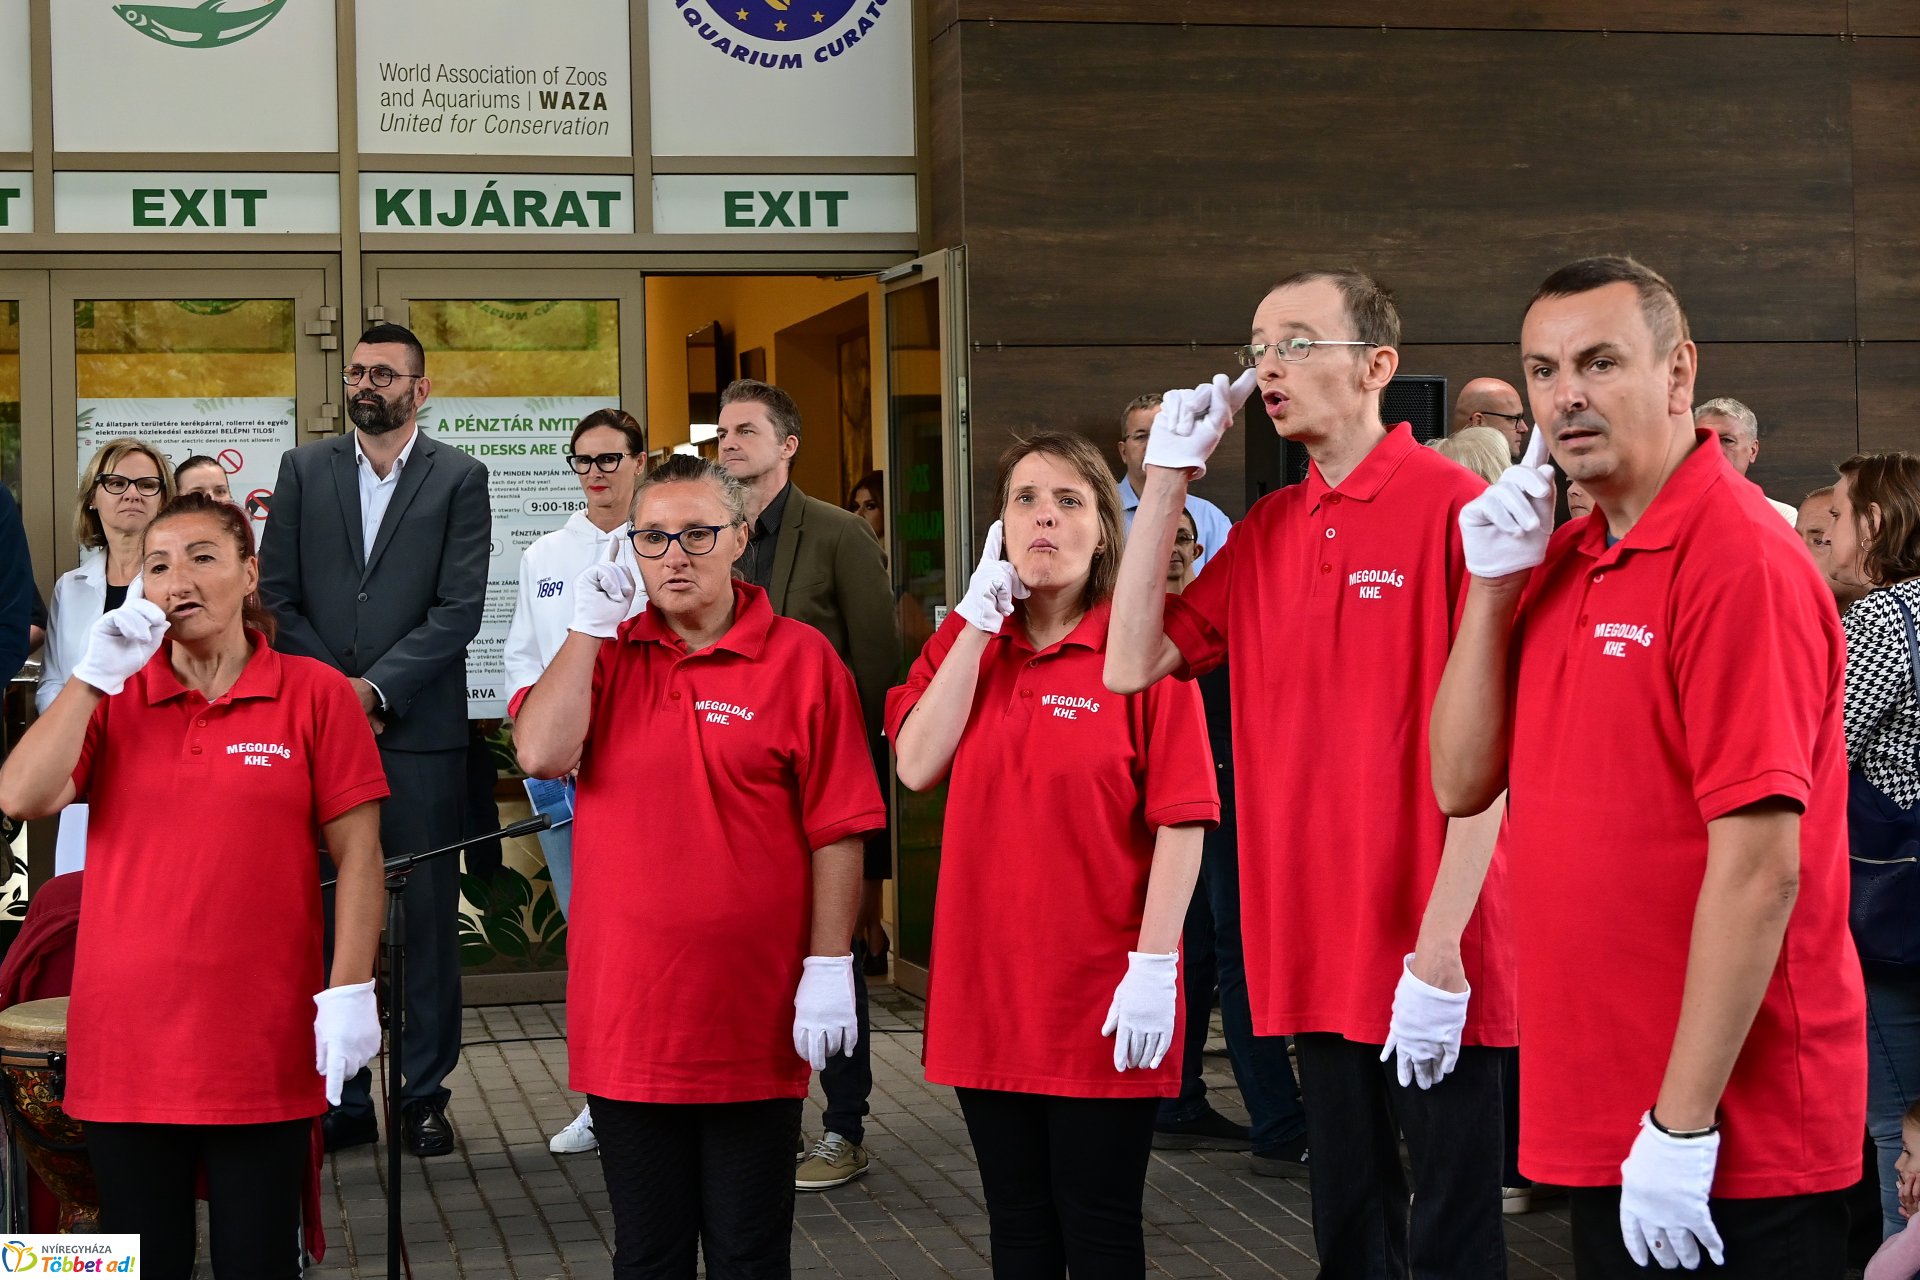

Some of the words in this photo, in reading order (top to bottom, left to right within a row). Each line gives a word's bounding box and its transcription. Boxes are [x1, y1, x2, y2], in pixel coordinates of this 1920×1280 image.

[379, 62, 431, 83] World
[436, 63, 536, 85] Association
[543, 66, 560, 85] of
[565, 66, 607, 86] Zoos
[380, 88, 414, 107] and
[421, 88, 520, 112] Aquariums
[539, 90, 608, 111] WAZA
[380, 113, 443, 133] United
[450, 113, 477, 134] for
[484, 114, 609, 136] Conservation
[132, 188, 268, 227] EXIT
[375, 180, 622, 228] KIJÁRAT
[724, 190, 849, 228] EXIT
[106, 420, 139, 428] állatpark
[437, 418, 449, 432] A
[454, 414, 534, 432] PÉNZTÁR
[539, 417, 580, 432] NYIT
[480, 443, 526, 455] DESKS
[529, 443, 557, 455] ARE
[531, 501, 588, 512] 9:00-18:0
[510, 529, 541, 537] PÉNZTÁR
[1348, 569, 1405, 588] MEGOLDÁS
[537, 581, 564, 598] 1889
[1359, 586, 1382, 599] KHE.
[1594, 623, 1654, 647] MEGOLDÁS
[1602, 640, 1626, 657] KHE.
[466, 687, 496, 698] ÁRVA
[694, 700, 754, 721] MEGOLDÁS
[1041, 694, 1100, 713] MEGOLDÁS
[706, 712, 730, 726] KHE.
[1053, 707, 1077, 720] KHE.
[226, 742, 291, 759] MEGOLDÁS
[244, 755, 272, 767] KHE.
